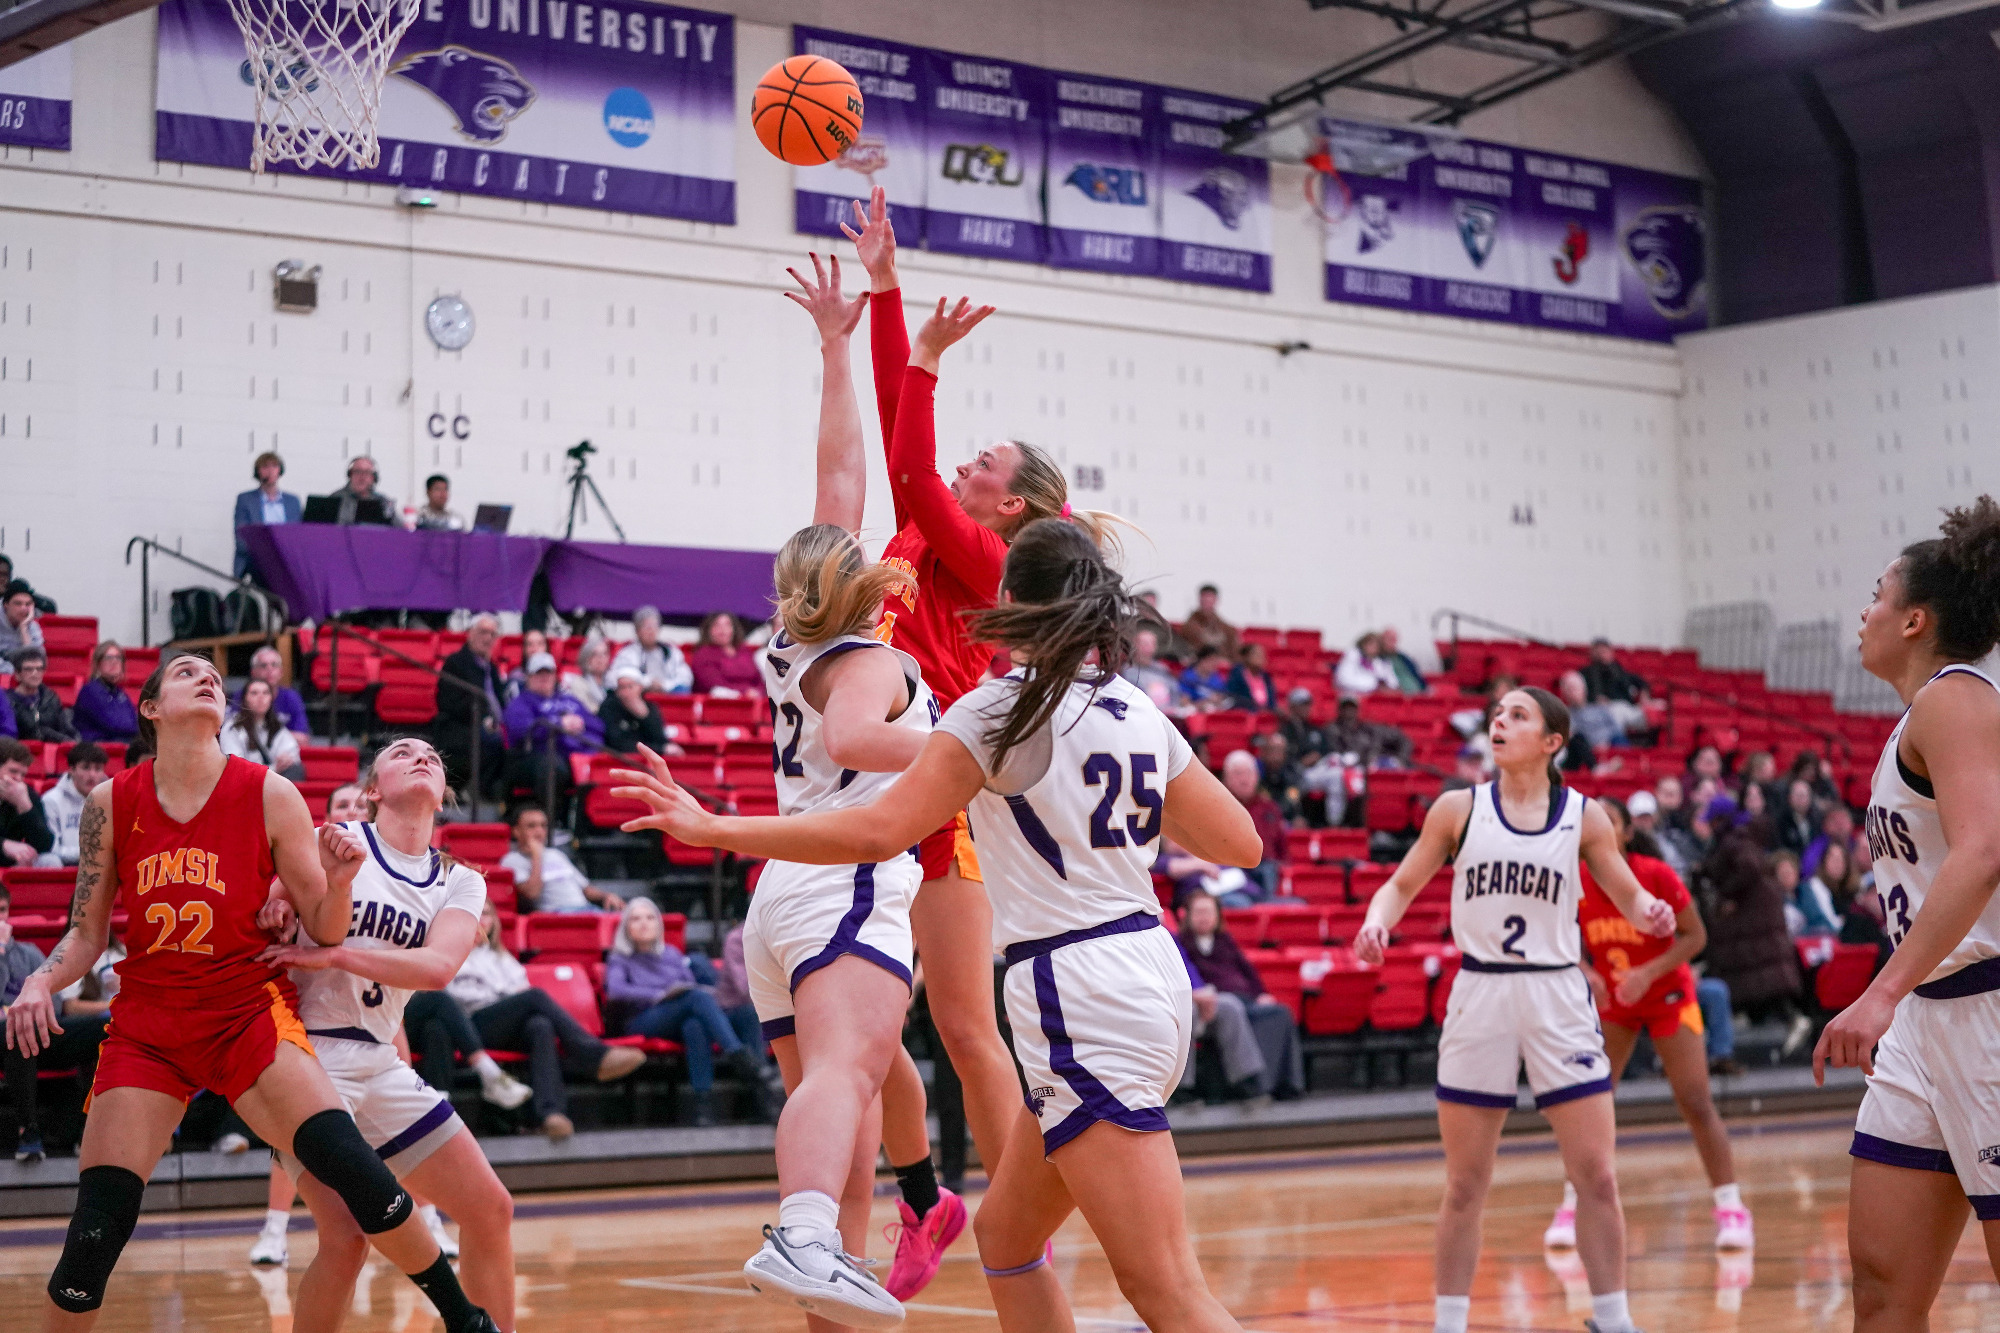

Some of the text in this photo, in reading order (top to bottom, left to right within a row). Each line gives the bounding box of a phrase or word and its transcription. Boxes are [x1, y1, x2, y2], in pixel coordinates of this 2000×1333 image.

[469, 0, 718, 62] UNIVERSITY
[936, 87, 1029, 122] UNIVERSITY
[428, 413, 470, 440] CC
[1081, 752, 1163, 850] 25
[137, 847, 226, 896] UMSL
[1465, 860, 1563, 905] BEARCAT
[145, 901, 214, 955] 22
[1502, 914, 1526, 959] 2
